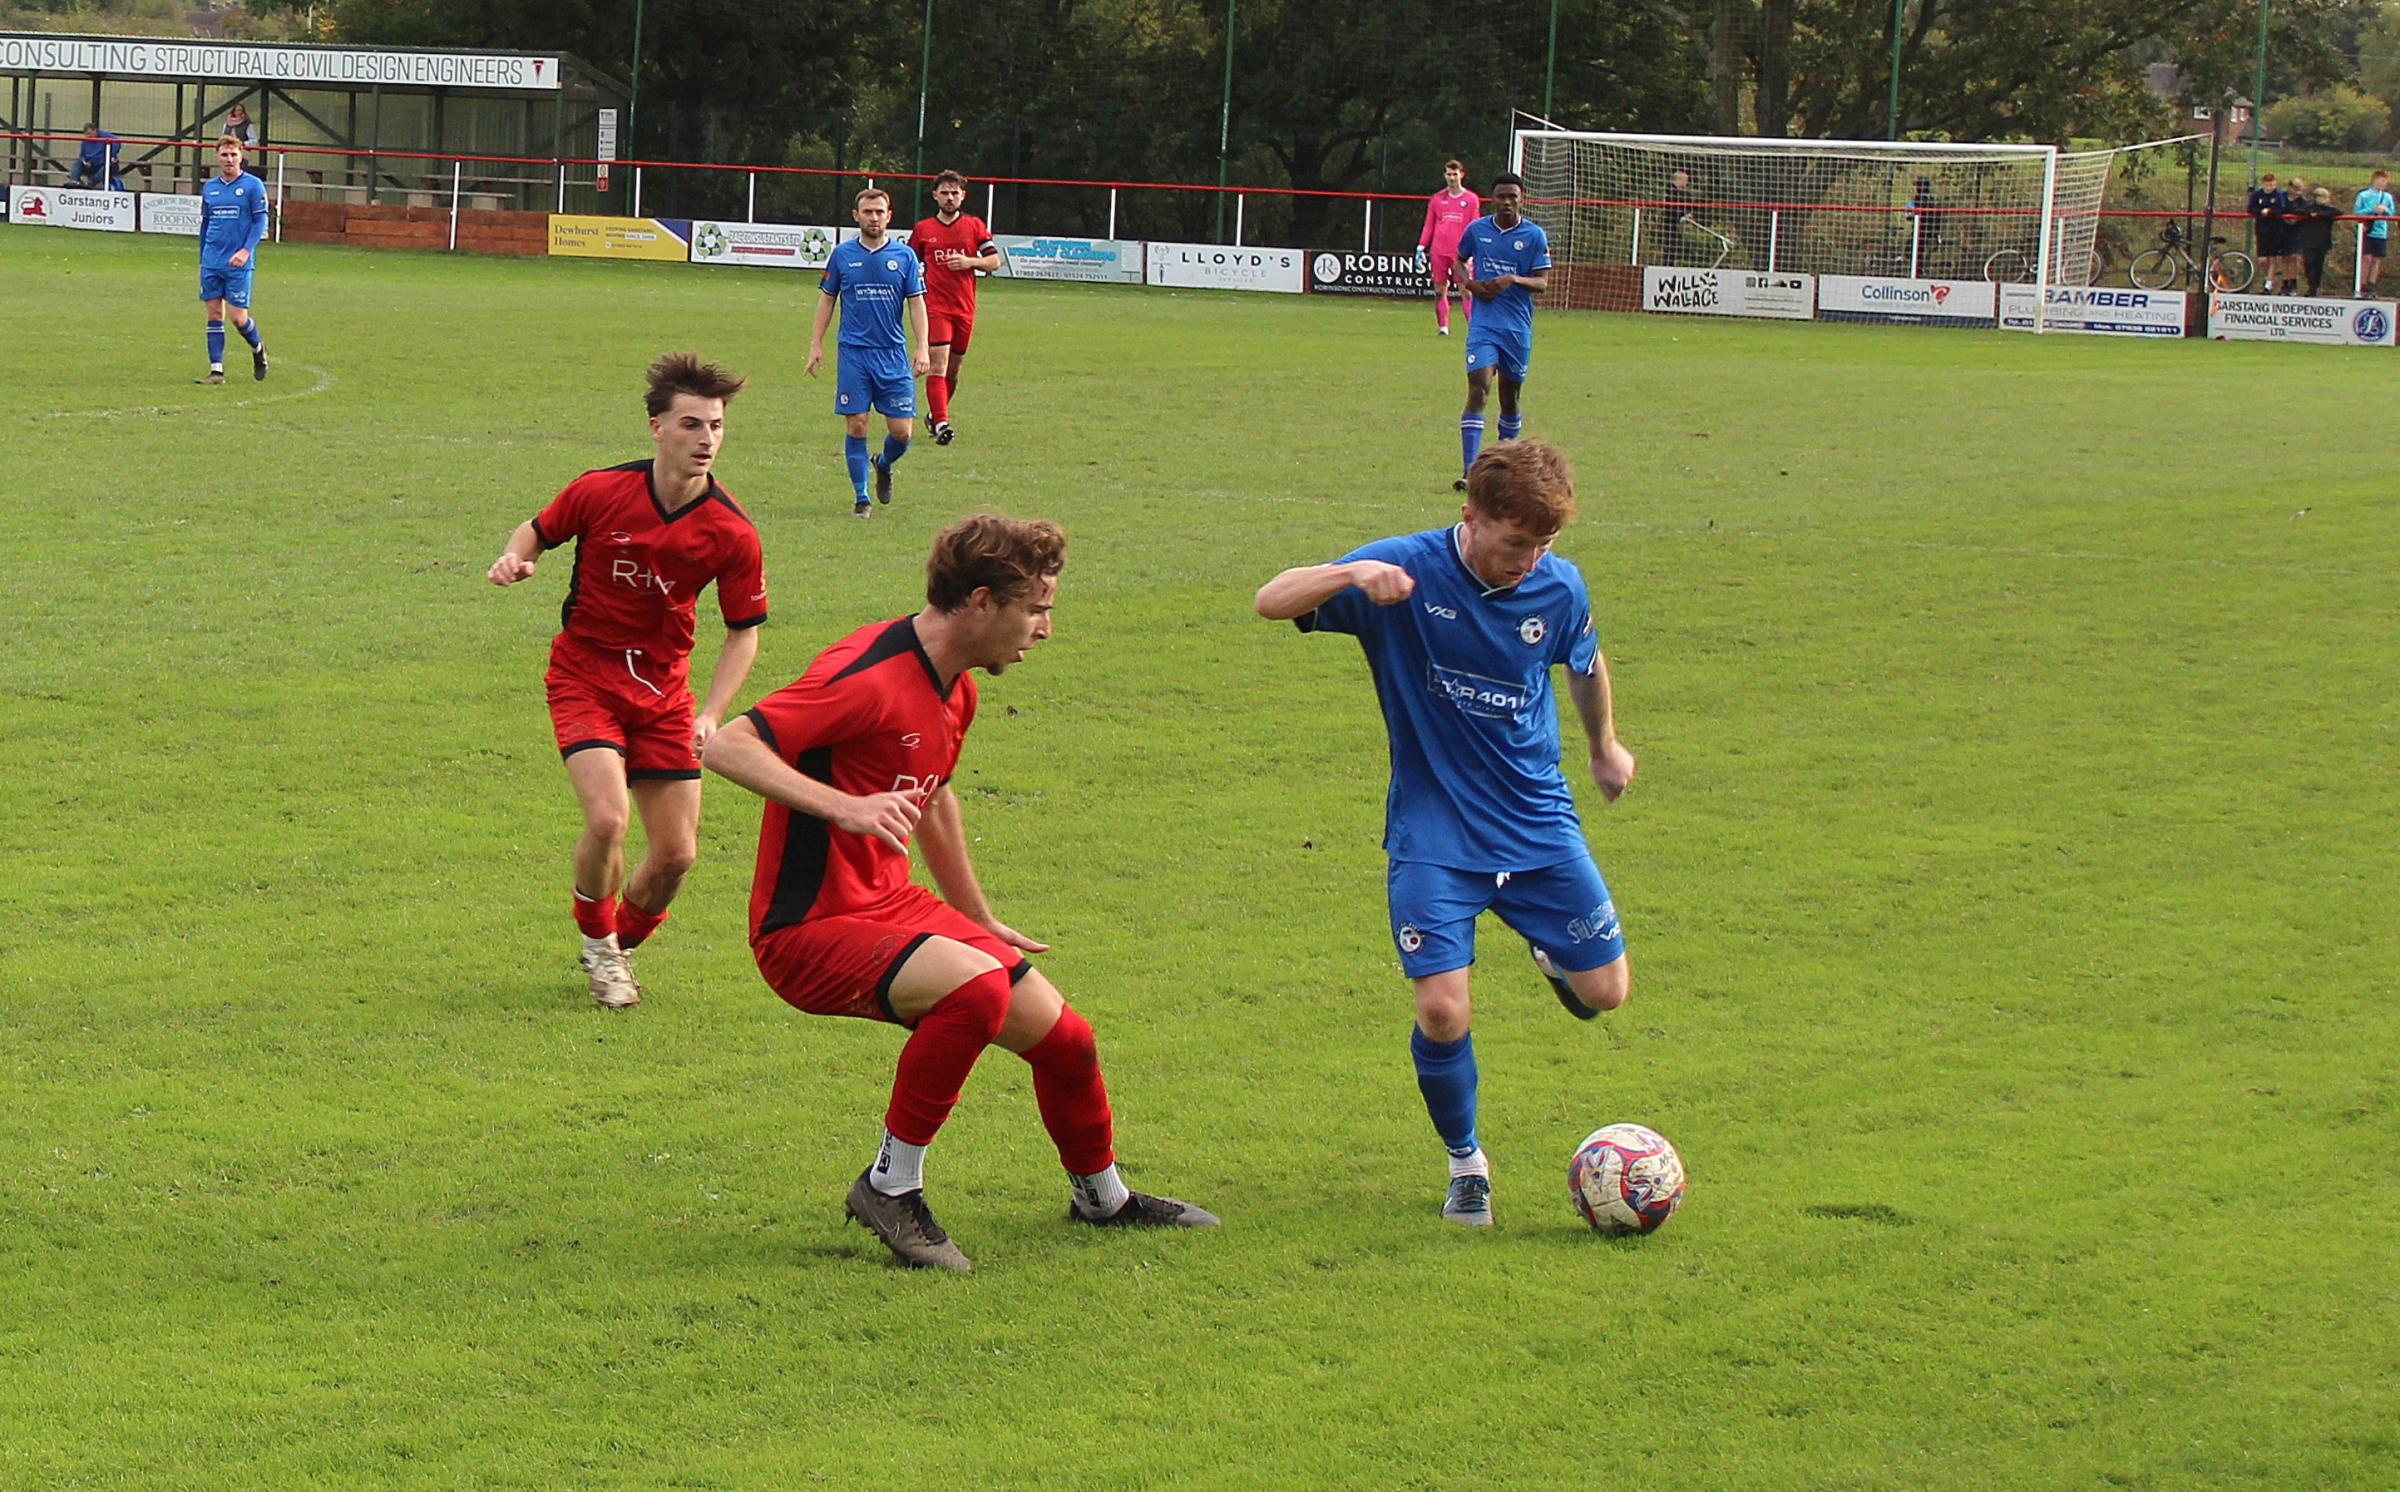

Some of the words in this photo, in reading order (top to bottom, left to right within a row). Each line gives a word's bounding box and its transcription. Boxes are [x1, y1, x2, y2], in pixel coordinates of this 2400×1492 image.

[0, 41, 147, 71] ONSULTING
[154, 47, 272, 77] STRUCTURAL
[276, 52, 290, 77] &
[293, 52, 338, 79] CIVIL
[342, 54, 411, 81] DESIGN
[415, 56, 523, 85] ENGINEERS
[58, 193, 110, 211] Garstang
[113, 197, 129, 209] FC
[71, 211, 115, 225] Juniors
[153, 213, 201, 225] ROOFING
[554, 224, 599, 236] Dewhurst
[554, 236, 586, 248] Homes
[1181, 251, 1291, 268] LLOYD'S
[1204, 267, 1268, 278] BICYCLE
[1653, 288, 1719, 308] WALLACE
[1861, 284, 1931, 302] Collinson
[2044, 289, 2149, 308] BAMBER
[2008, 304, 2085, 318] PLUBING
[2114, 309, 2178, 322] HEATING
[2216, 300, 2270, 313] GARSTANG
[2272, 302, 2345, 317] INDEPENDENT
[2224, 312, 2279, 326] FINANCIAL
[2281, 316, 2332, 329] SERVICES
[1477, 691, 1518, 710] 401
